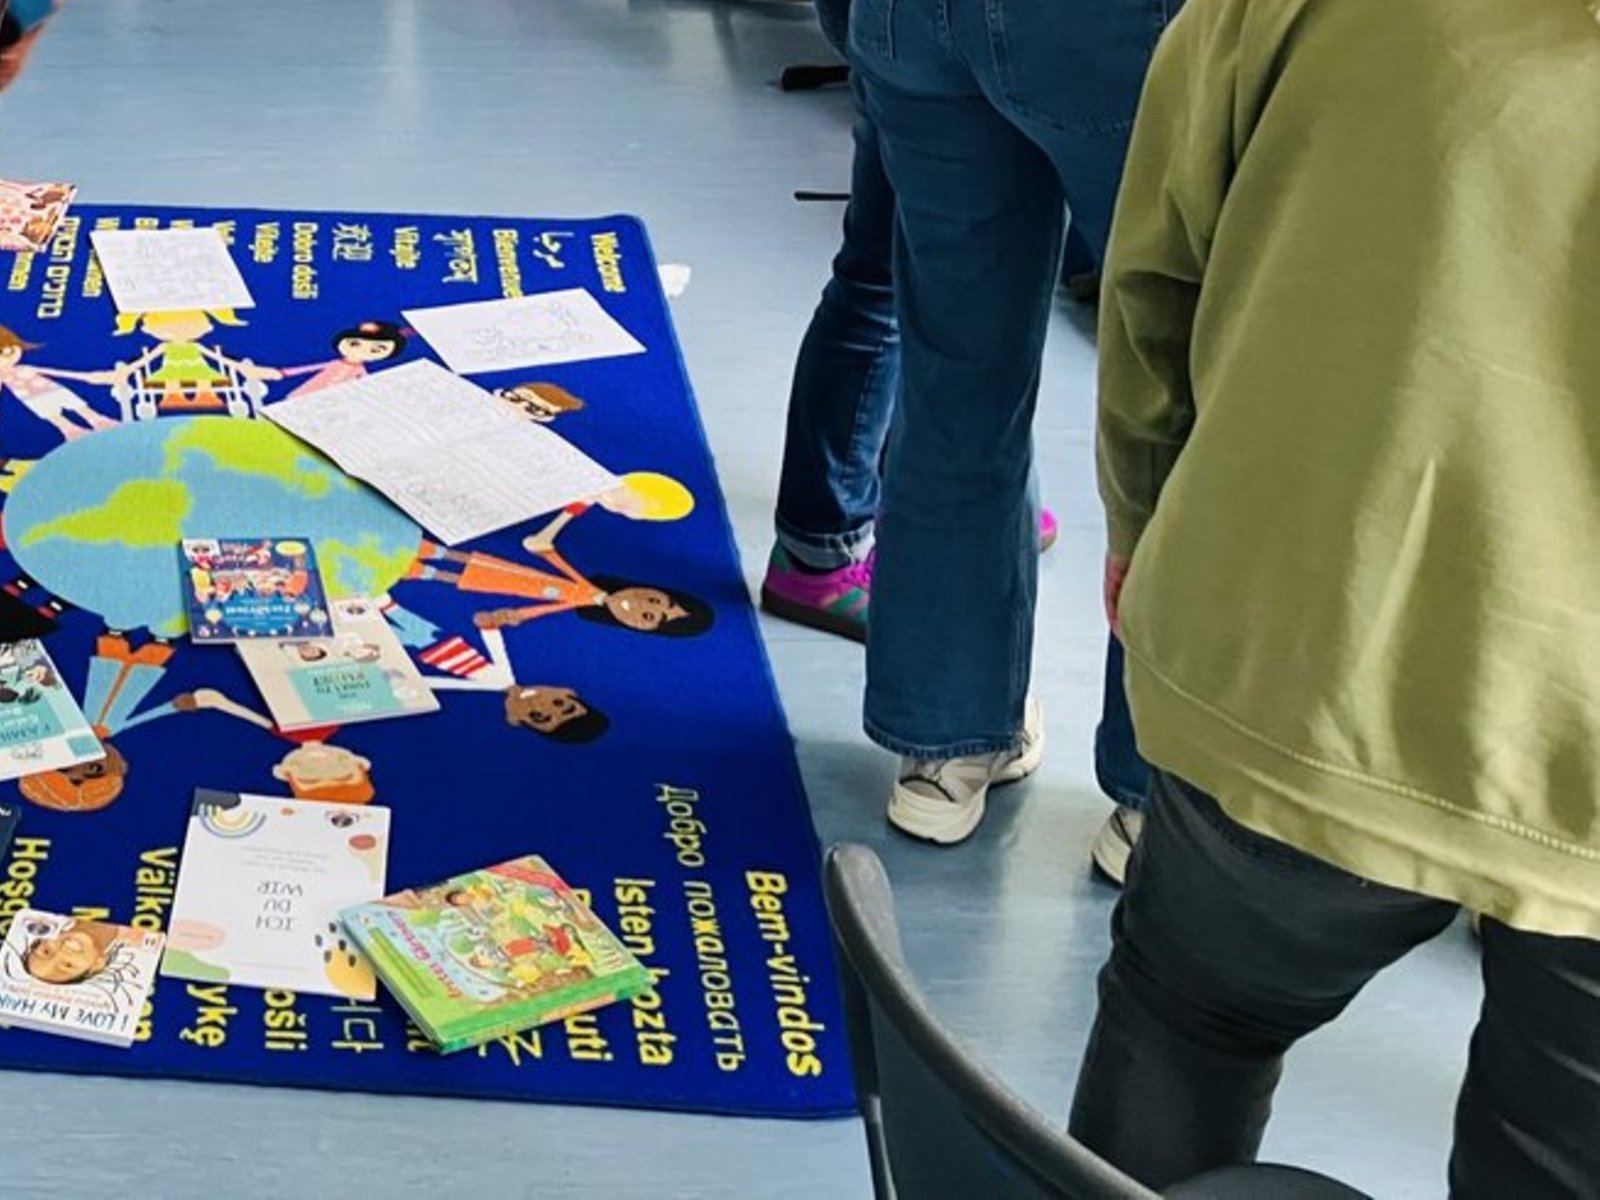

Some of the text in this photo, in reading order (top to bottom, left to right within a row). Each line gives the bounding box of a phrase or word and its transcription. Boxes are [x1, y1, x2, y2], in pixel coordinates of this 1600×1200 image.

[293, 222, 318, 262] Dobro
[590, 231, 627, 293] Welcome
[256, 880, 304, 897] WIR
[264, 898, 291, 913] DU
[256, 915, 293, 931] ICH
[613, 876, 658, 956] Isten
[655, 784, 749, 1072] Добро пожаловать
[744, 869, 826, 1078] Bem-vindos
[78, 1008, 116, 1031] LOVE
